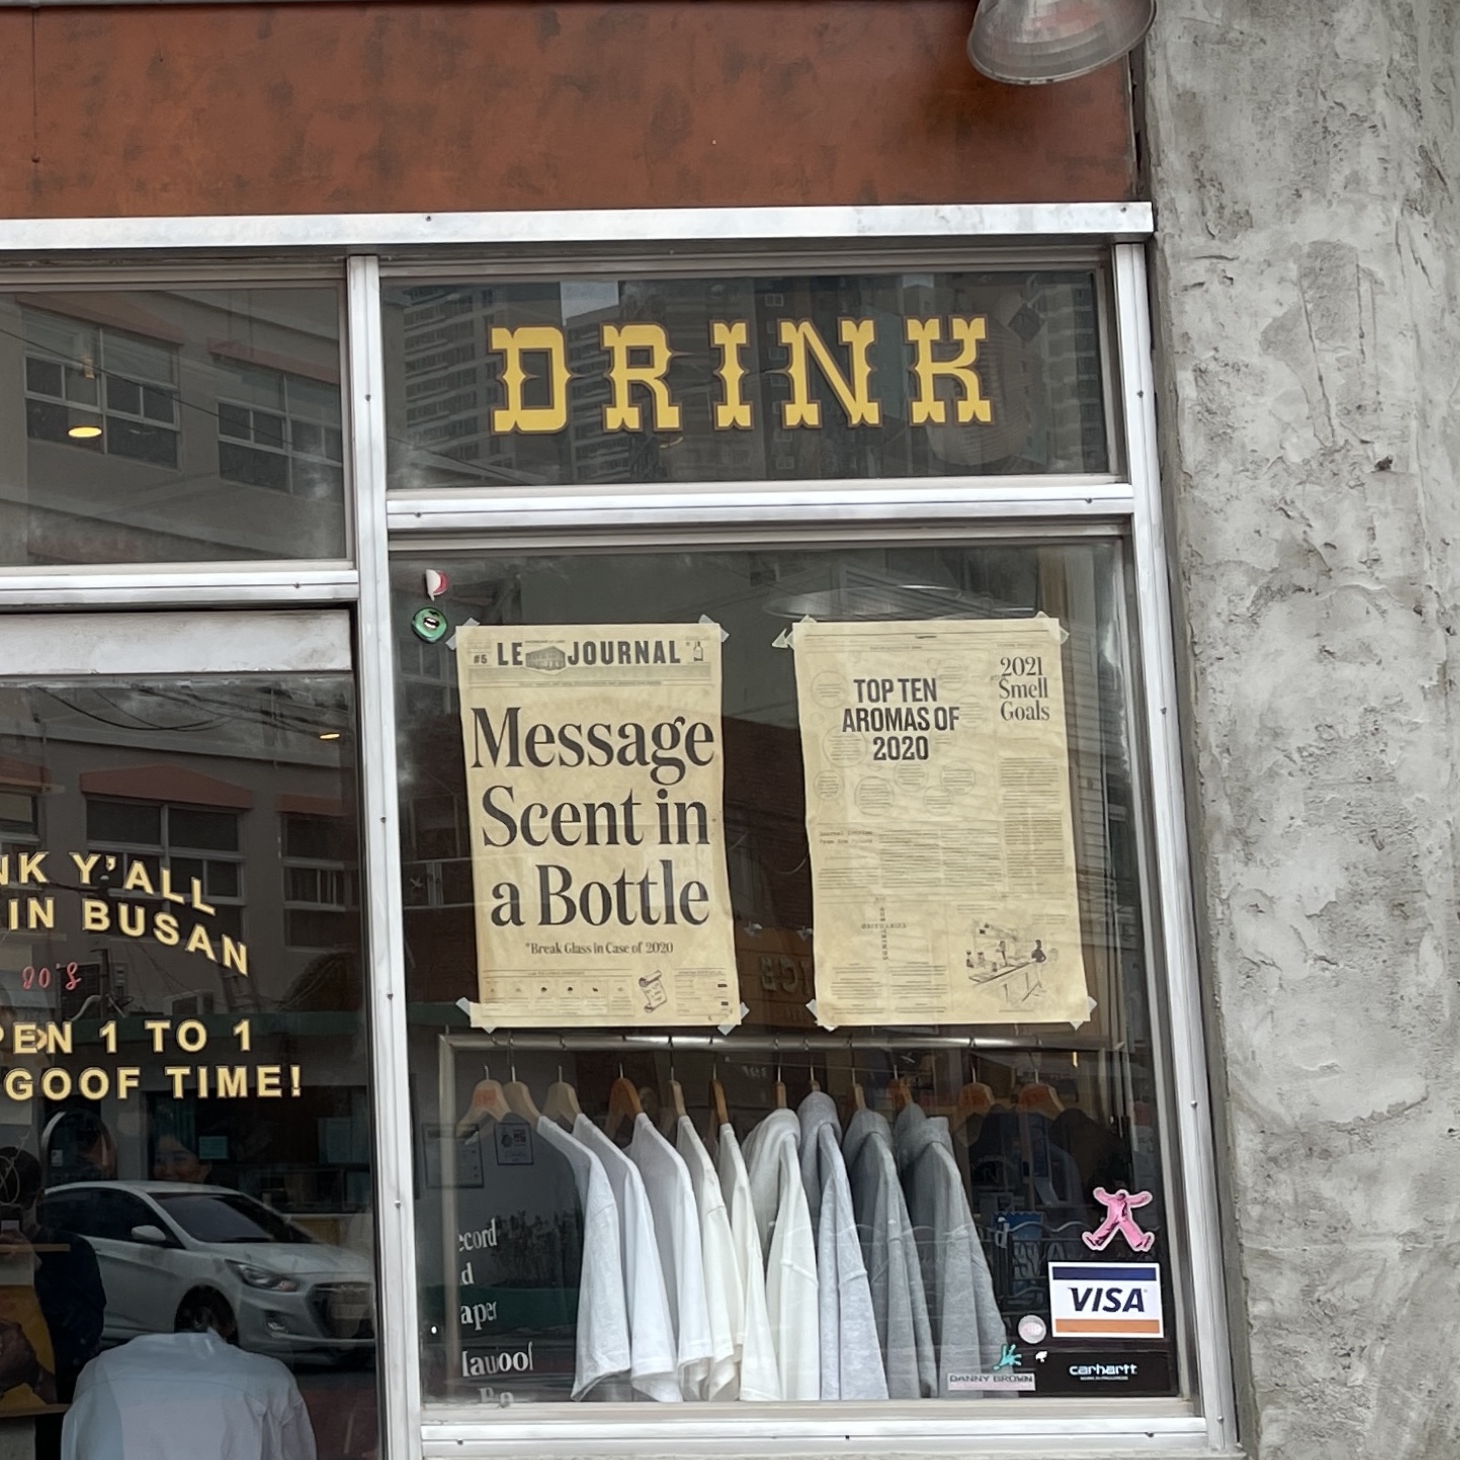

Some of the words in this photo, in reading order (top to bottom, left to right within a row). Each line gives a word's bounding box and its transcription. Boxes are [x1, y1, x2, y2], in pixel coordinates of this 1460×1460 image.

[489, 315, 994, 435] DRINK
[497, 642, 523, 666] LE
[567, 640, 681, 665] JOURNAL
[1000, 656, 1043, 677] 2021
[853, 679, 894, 703] TOP
[897, 678, 938, 702] TEN
[999, 678, 1049, 699] Smell
[842, 707, 930, 732] AROMAS
[934, 706, 960, 731] OF
[1001, 700, 1050, 721] Goals
[471, 707, 714, 785] Message
[873, 736, 929, 761] 2020
[482, 785, 644, 847] Scent
[655, 788, 711, 845] in
[491, 882, 526, 926] a
[535, 859, 710, 926] Bottle
[9, 897, 55, 930] IN
[82, 897, 248, 977] BUSAN
[564, 942, 591, 954] Glass
[593, 942, 604, 954] in
[605, 942, 629, 954] Case
[631, 942, 643, 954] of
[645, 942, 673, 954] 2020
[100, 1021, 117, 1053] 1
[145, 1019, 207, 1052] TO
[233, 1019, 251, 1051] 1
[4, 1067, 140, 1100] GOOF
[164, 1065, 300, 1099] TIME!
[1069, 1287, 1145, 1313] VISA
[460, 1301, 497, 1331] aper
[1069, 1364, 1137, 1376] carhartt
